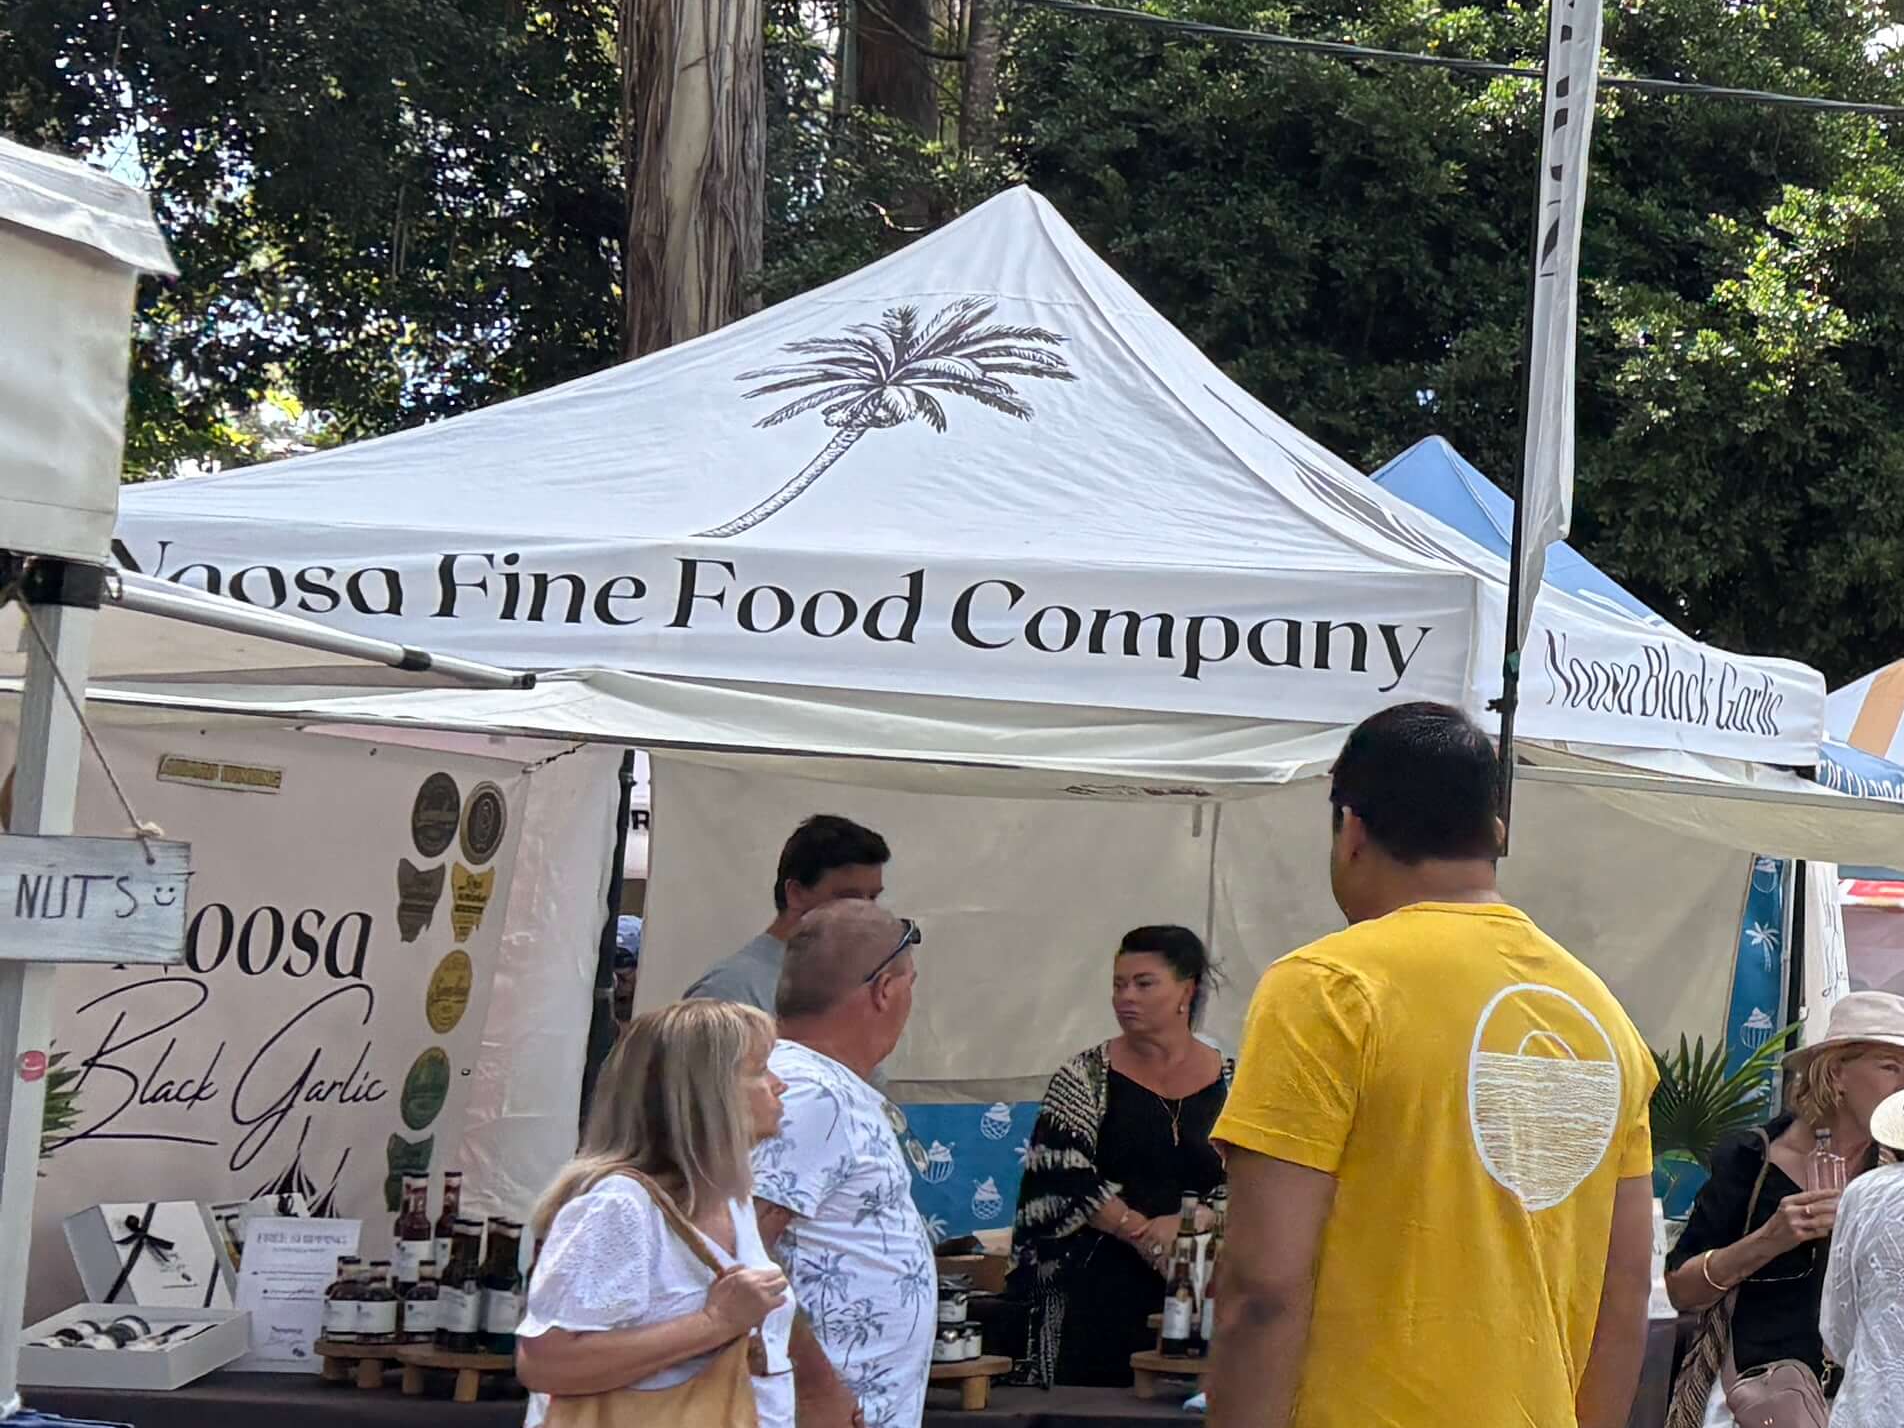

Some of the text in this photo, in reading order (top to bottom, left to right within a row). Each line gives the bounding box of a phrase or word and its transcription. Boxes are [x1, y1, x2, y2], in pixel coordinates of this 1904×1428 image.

[430, 551, 647, 627] Fine
[664, 556, 925, 644] Food
[951, 579, 1431, 693] Company
[1545, 628, 1783, 736] Noosa Black Garlic
[43, 977, 389, 1172] Black Garlic
